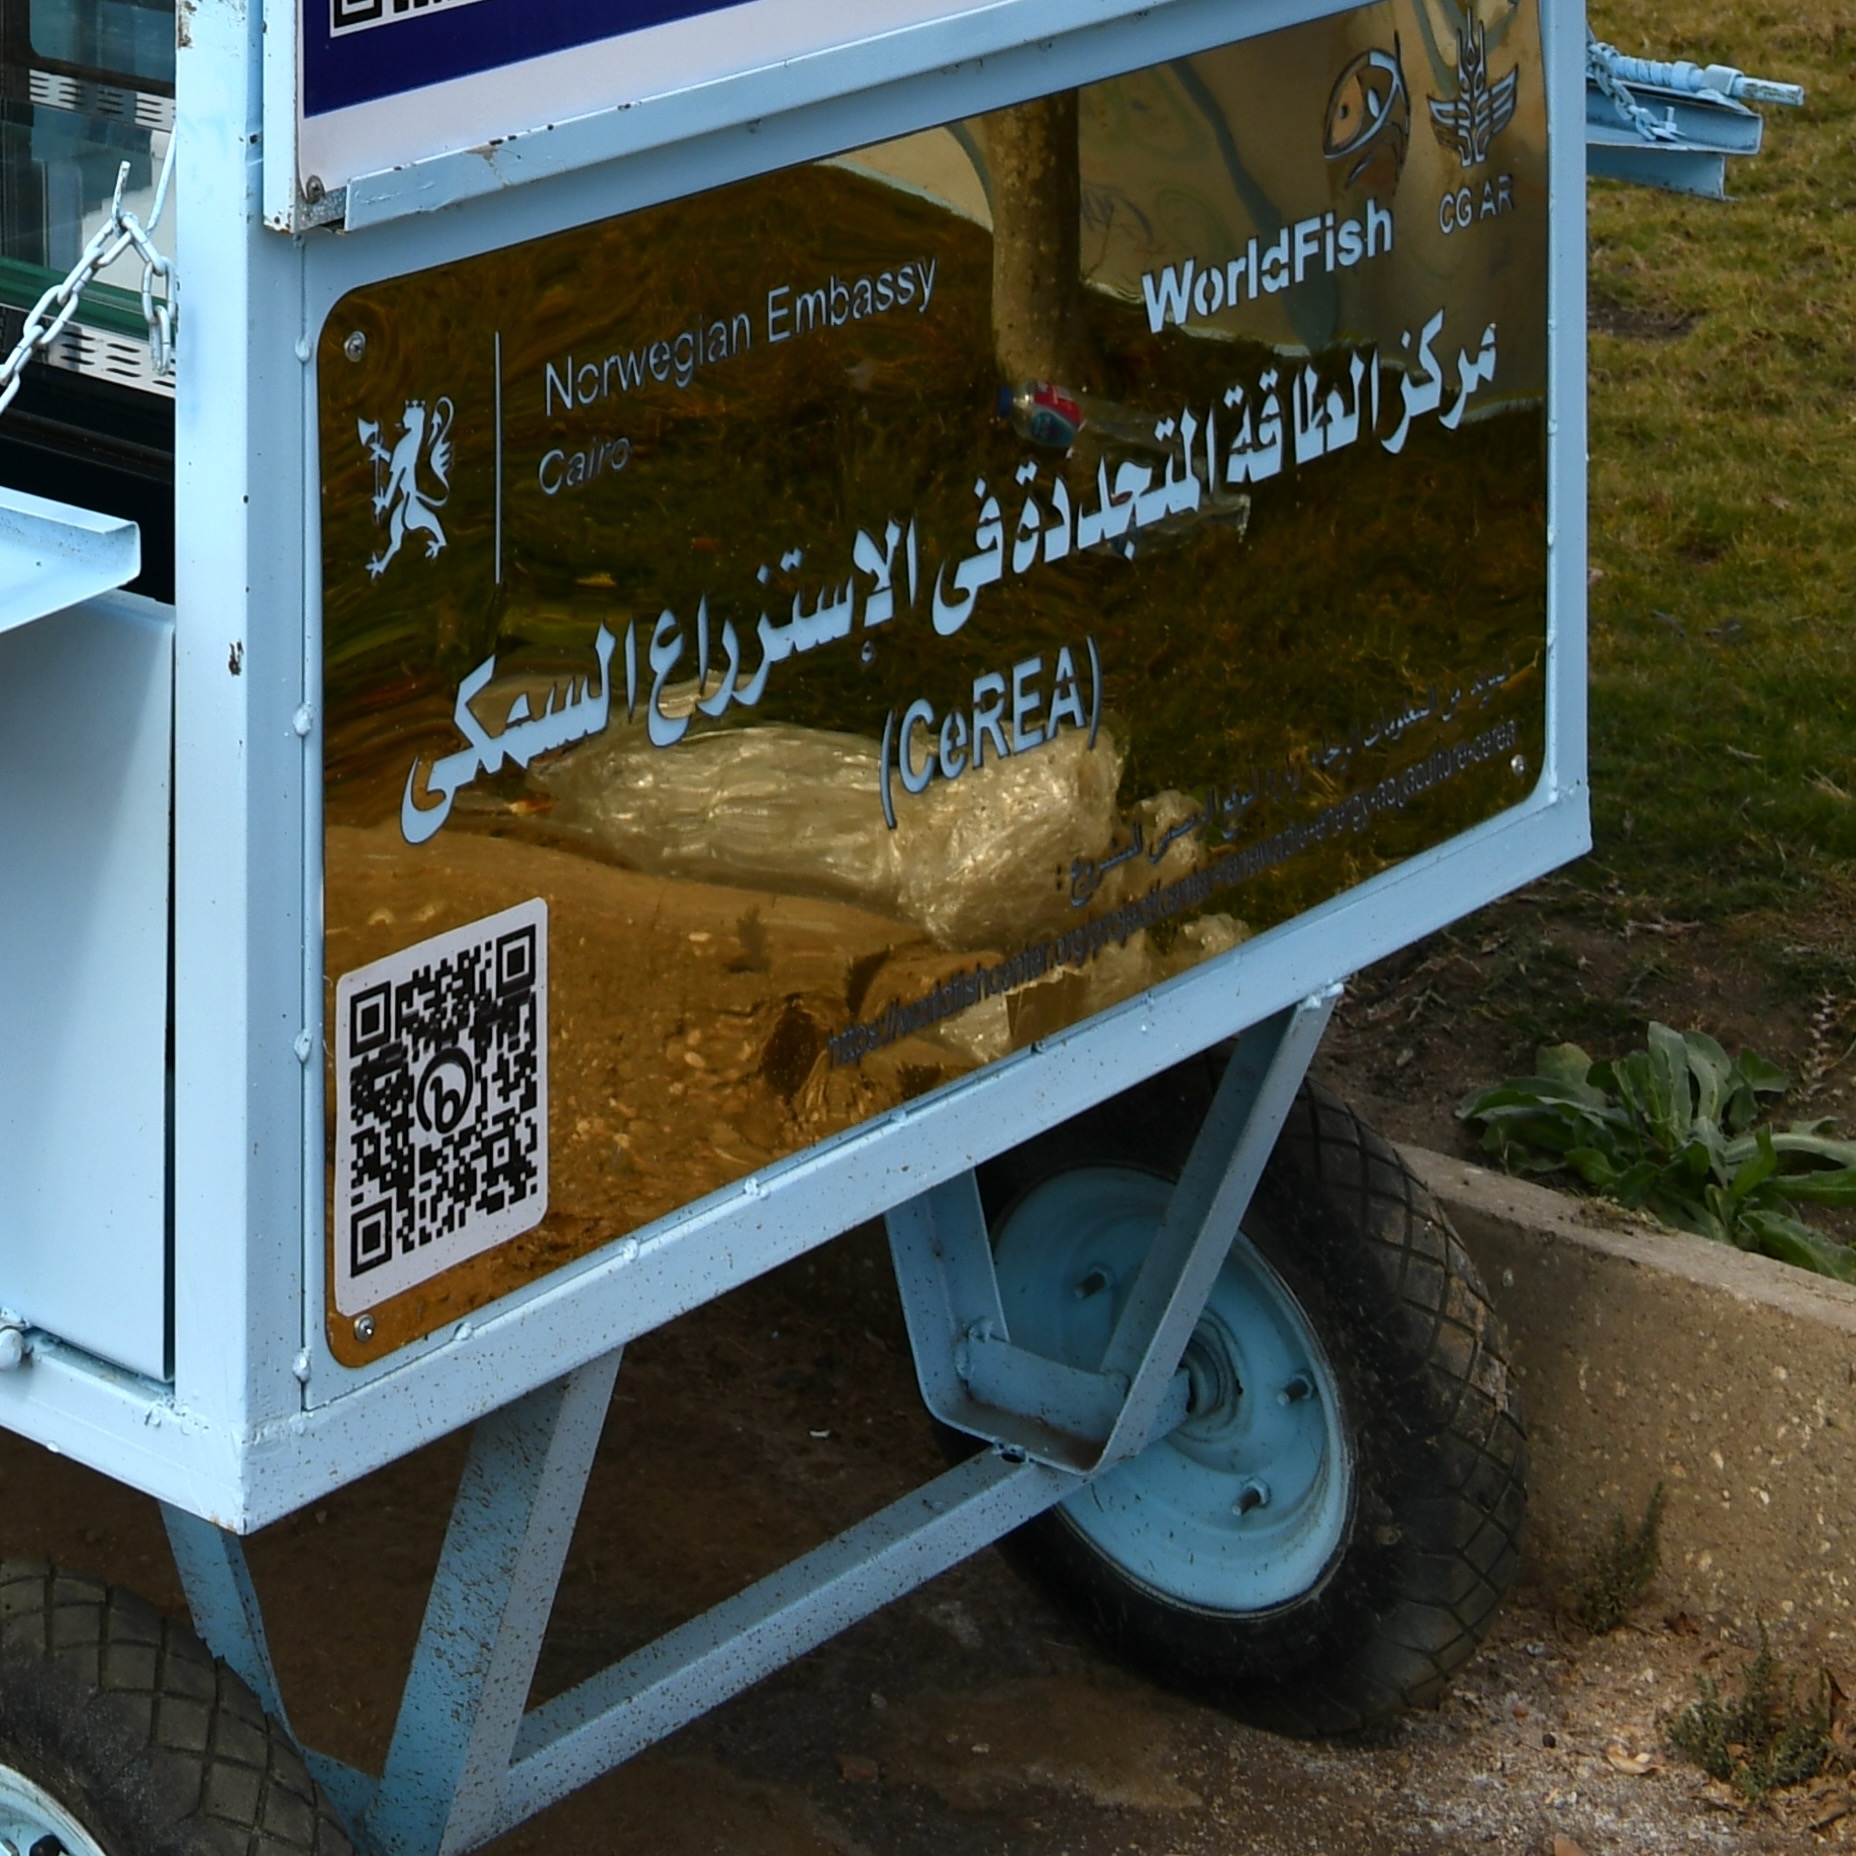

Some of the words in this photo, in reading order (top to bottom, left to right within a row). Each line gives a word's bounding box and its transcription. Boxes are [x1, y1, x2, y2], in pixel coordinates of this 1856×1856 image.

[1142, 197, 1395, 335] WorldFish
[1438, 173, 1515, 236] CGAR
[545, 311, 753, 418] Norwegian
[766, 257, 938, 345] Embassy
[1380, 308, 1498, 455] مركز
[537, 436, 633, 497] Cairo
[1225, 346, 1381, 485] الطاقة
[1012, 405, 1217, 575] المتجددة
[880, 634, 1105, 830] (CeREA)
